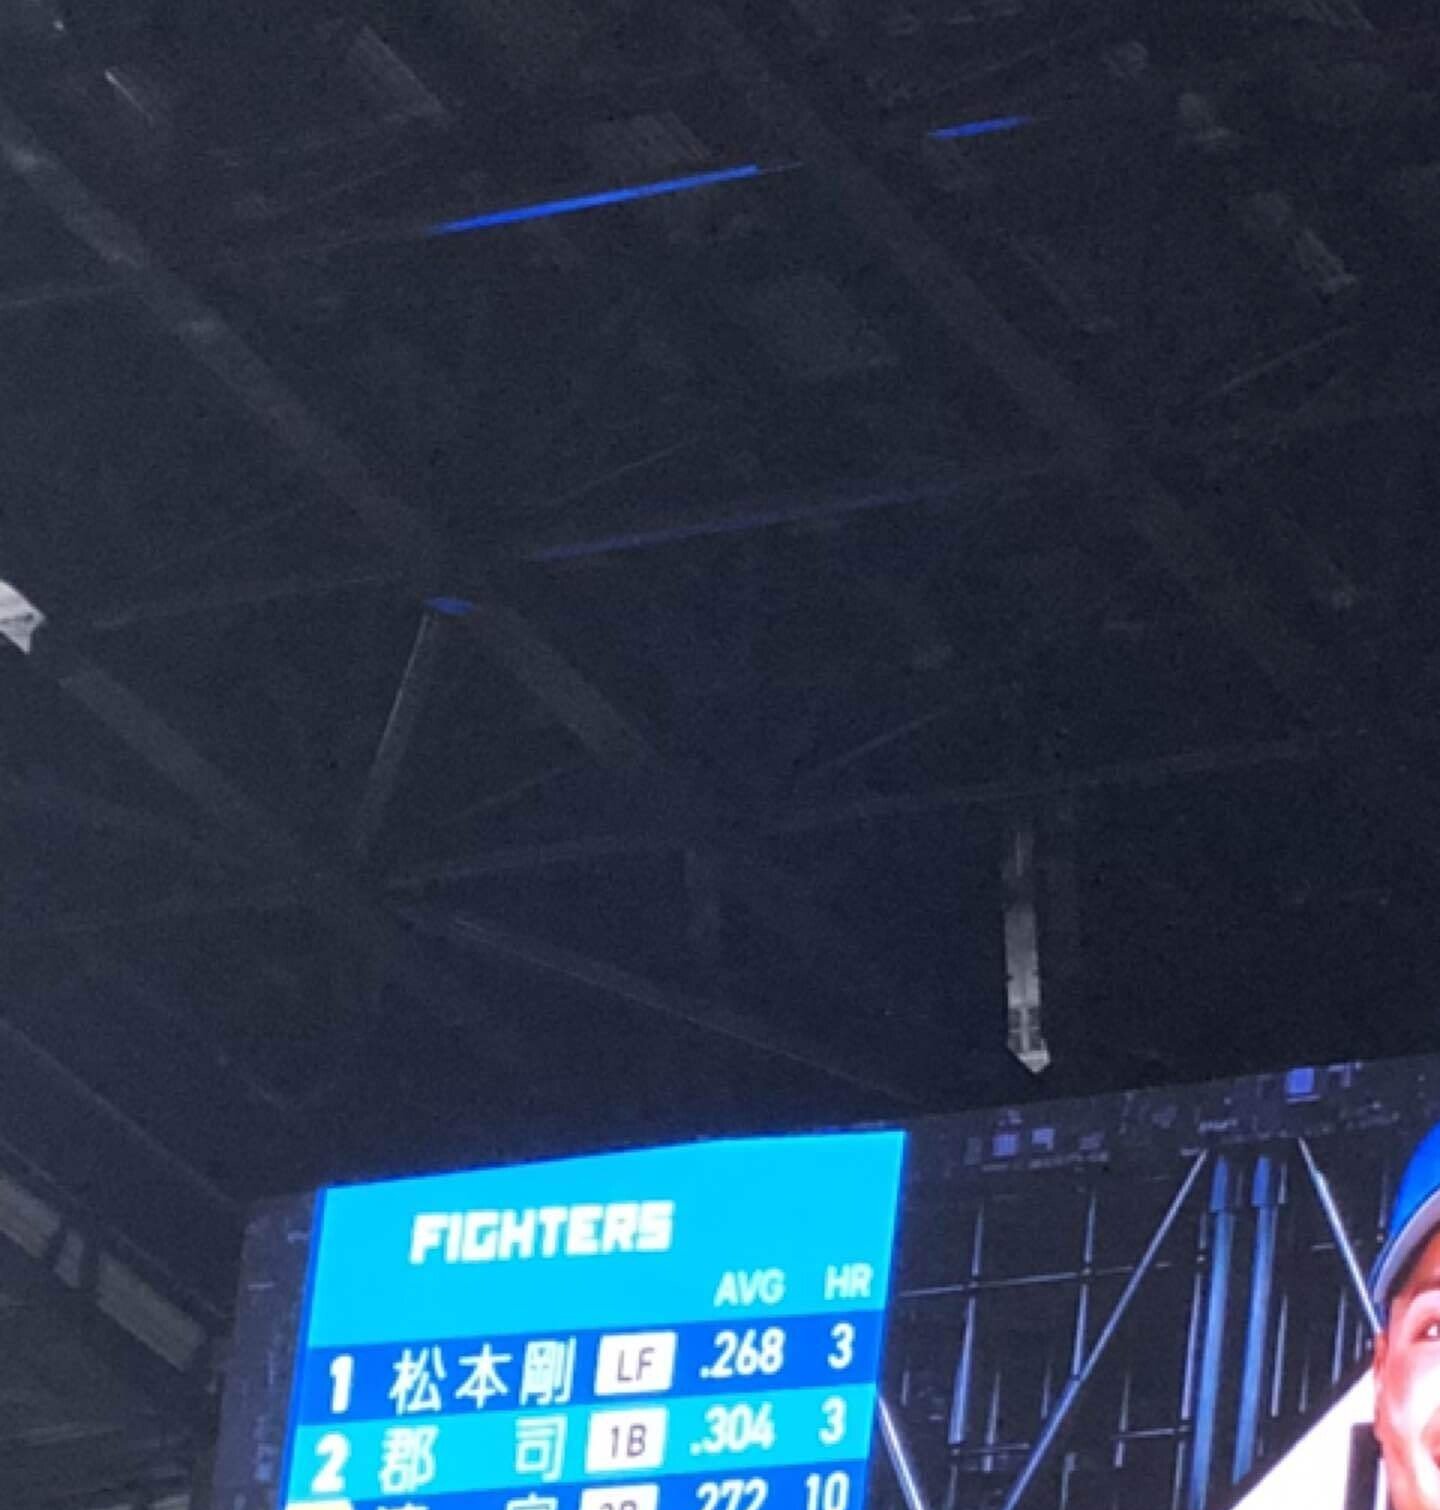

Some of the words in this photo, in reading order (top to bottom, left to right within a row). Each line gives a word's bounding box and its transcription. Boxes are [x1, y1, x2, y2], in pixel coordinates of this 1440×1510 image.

[411, 1201, 673, 1263] FIGHTERS
[715, 1269, 784, 1305] AVG
[826, 1263, 872, 1298] HR
[331, 1356, 352, 1412] 1
[617, 1347, 654, 1381] LF
[701, 1328, 784, 1377] .268
[828, 1323, 853, 1368] 3
[312, 1434, 348, 1500] 2
[612, 1425, 646, 1457] 1B
[692, 1404, 774, 1454] .304
[820, 1398, 845, 1444] 3
